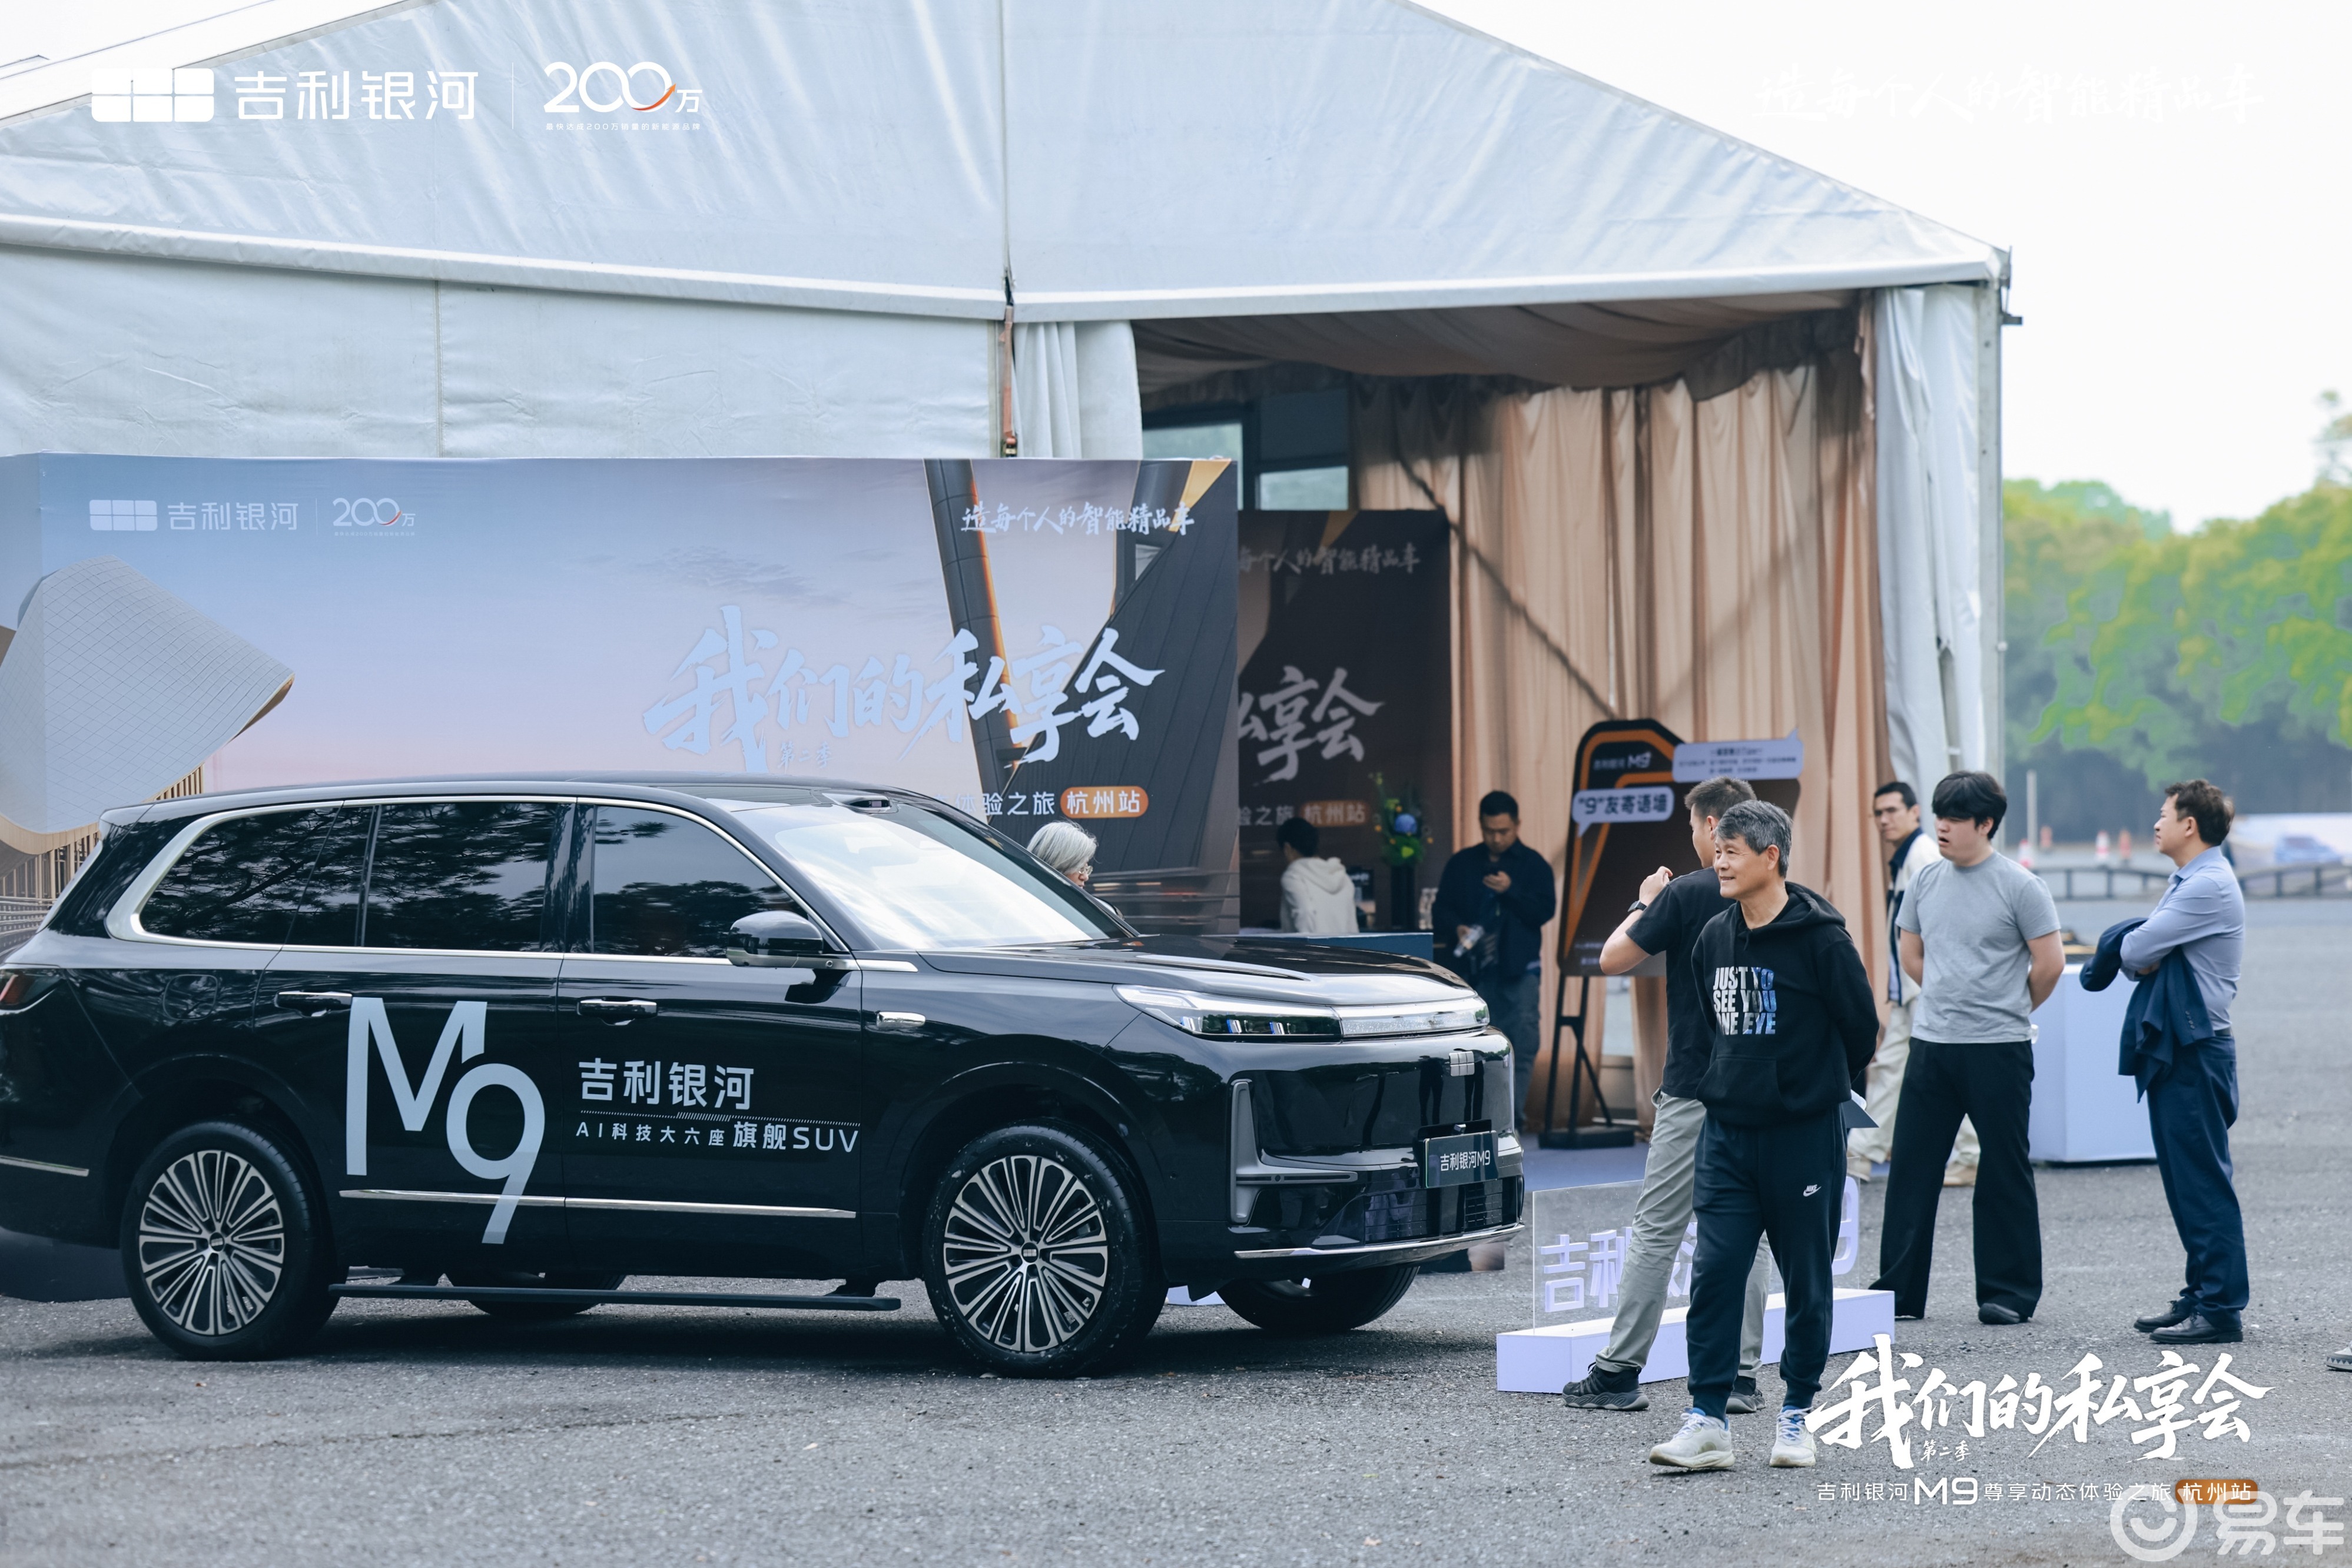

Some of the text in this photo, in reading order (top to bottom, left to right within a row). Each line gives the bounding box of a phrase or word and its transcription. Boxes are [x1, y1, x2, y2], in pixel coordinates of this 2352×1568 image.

[167, 502, 298, 530] 吉利银河
[332, 497, 416, 527] 200万
[960, 501, 1195, 536] 造每个人的智能精品车
[643, 605, 1165, 773] 我们的私享会
[777, 740, 834, 775] 第二季
[1067, 790, 1141, 815] 杭州站
[1303, 804, 1367, 824] 杭州站
[1713, 966, 1775, 991] JUST TO
[1713, 990, 1777, 1012] SEE YOU
[1743, 1012, 1776, 1035] EYE
[578, 1058, 755, 1111] 吉利银河
[346, 997, 546, 1244] M9
[1439, 1150, 1491, 1171] 吉利银河M9
[1806, 1184, 1817, 1192] NIKE
